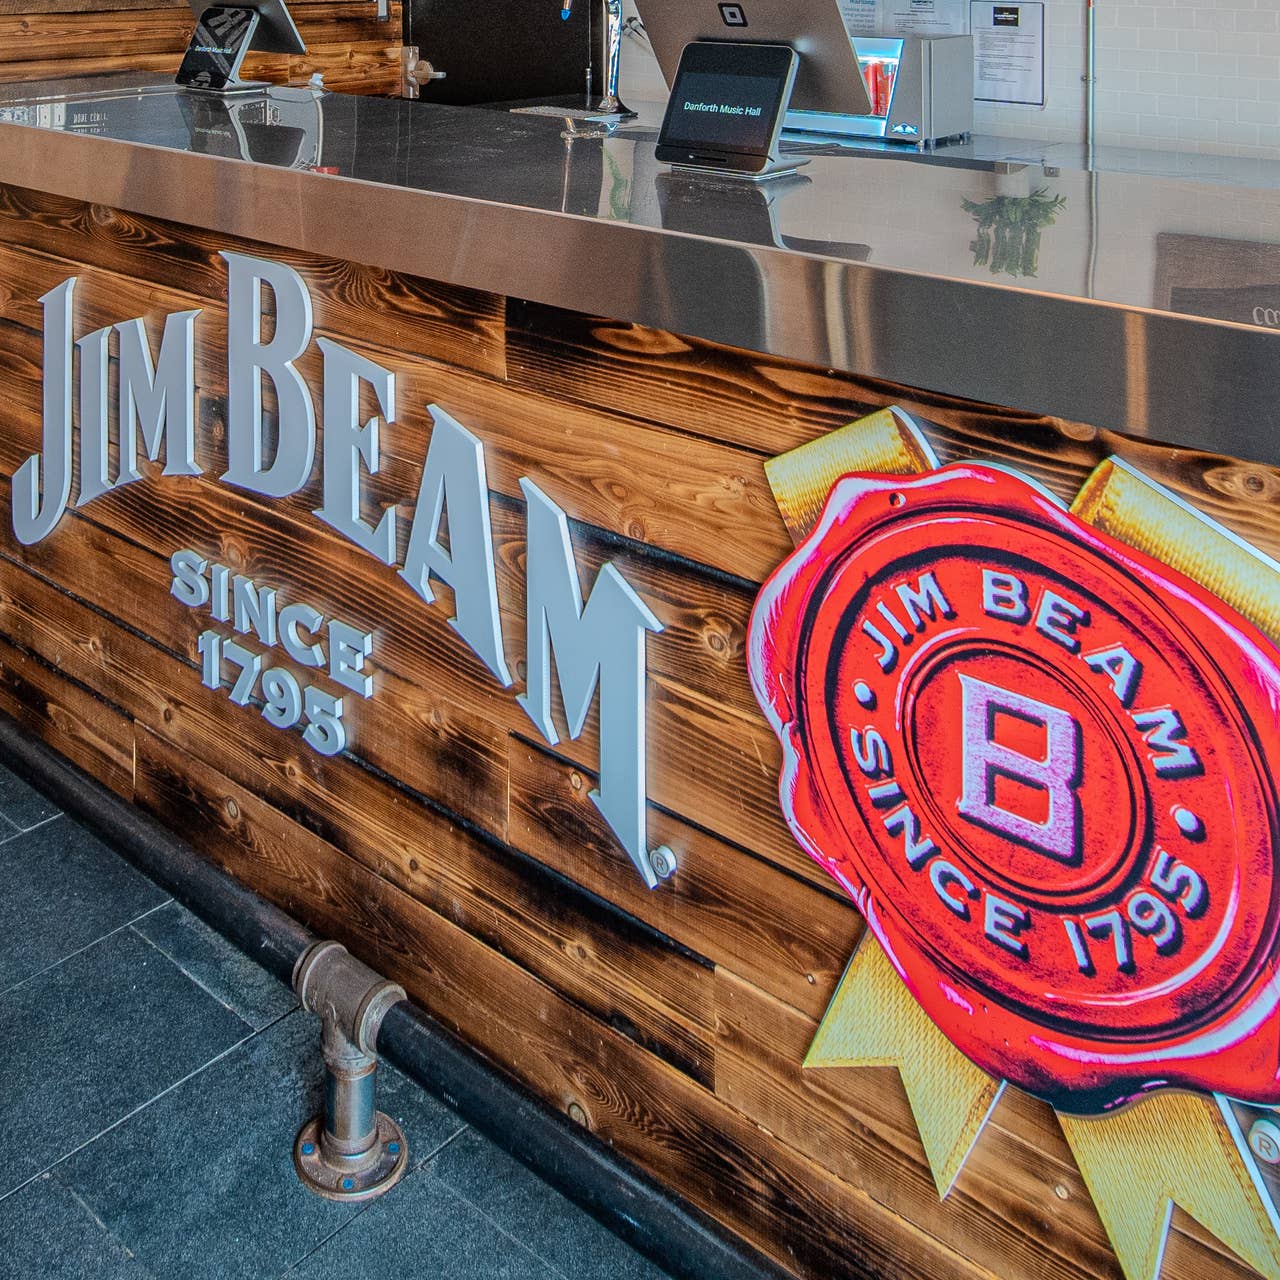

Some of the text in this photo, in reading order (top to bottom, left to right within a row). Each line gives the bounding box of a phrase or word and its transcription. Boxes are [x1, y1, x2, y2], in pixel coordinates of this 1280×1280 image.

[684, 101, 761, 116] Danforth Music Hall
[11, 277, 203, 544] JIM
[219, 250, 664, 889] BEAM
[169, 548, 374, 699] SINCE
[198, 630, 346, 756] 1795
[859, 568, 1204, 780] JIM BEAM
[957, 671, 1080, 865] B
[848, 725, 1211, 976] SINCE 1795
